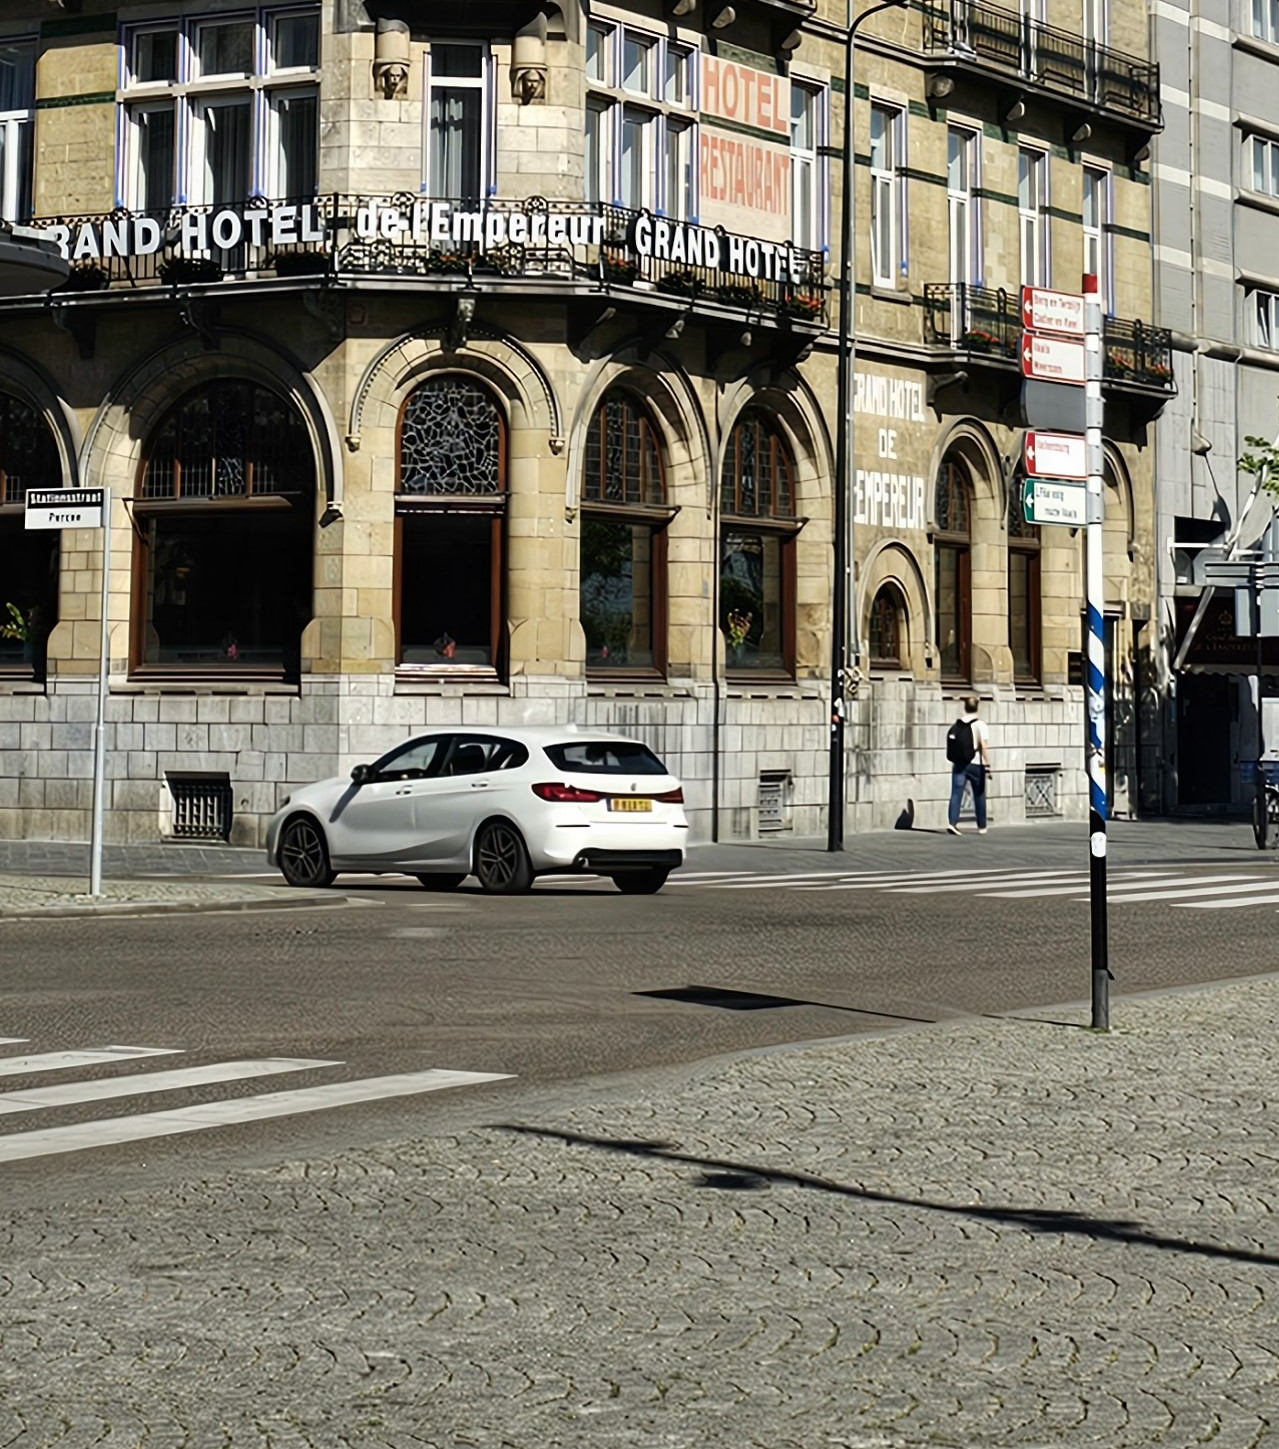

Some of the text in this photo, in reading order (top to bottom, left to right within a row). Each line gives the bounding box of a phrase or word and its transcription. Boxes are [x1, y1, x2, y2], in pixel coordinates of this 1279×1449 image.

[701, 57, 788, 133] HOTEL
[700, 132, 791, 217] RESTAURANT
[47, 203, 324, 260] RAND HOTEL
[357, 202, 605, 257] de l'Empereur
[635, 215, 800, 284] GRAND HOTEL
[889, 377, 926, 423] HOTEL
[878, 428, 898, 460] DE
